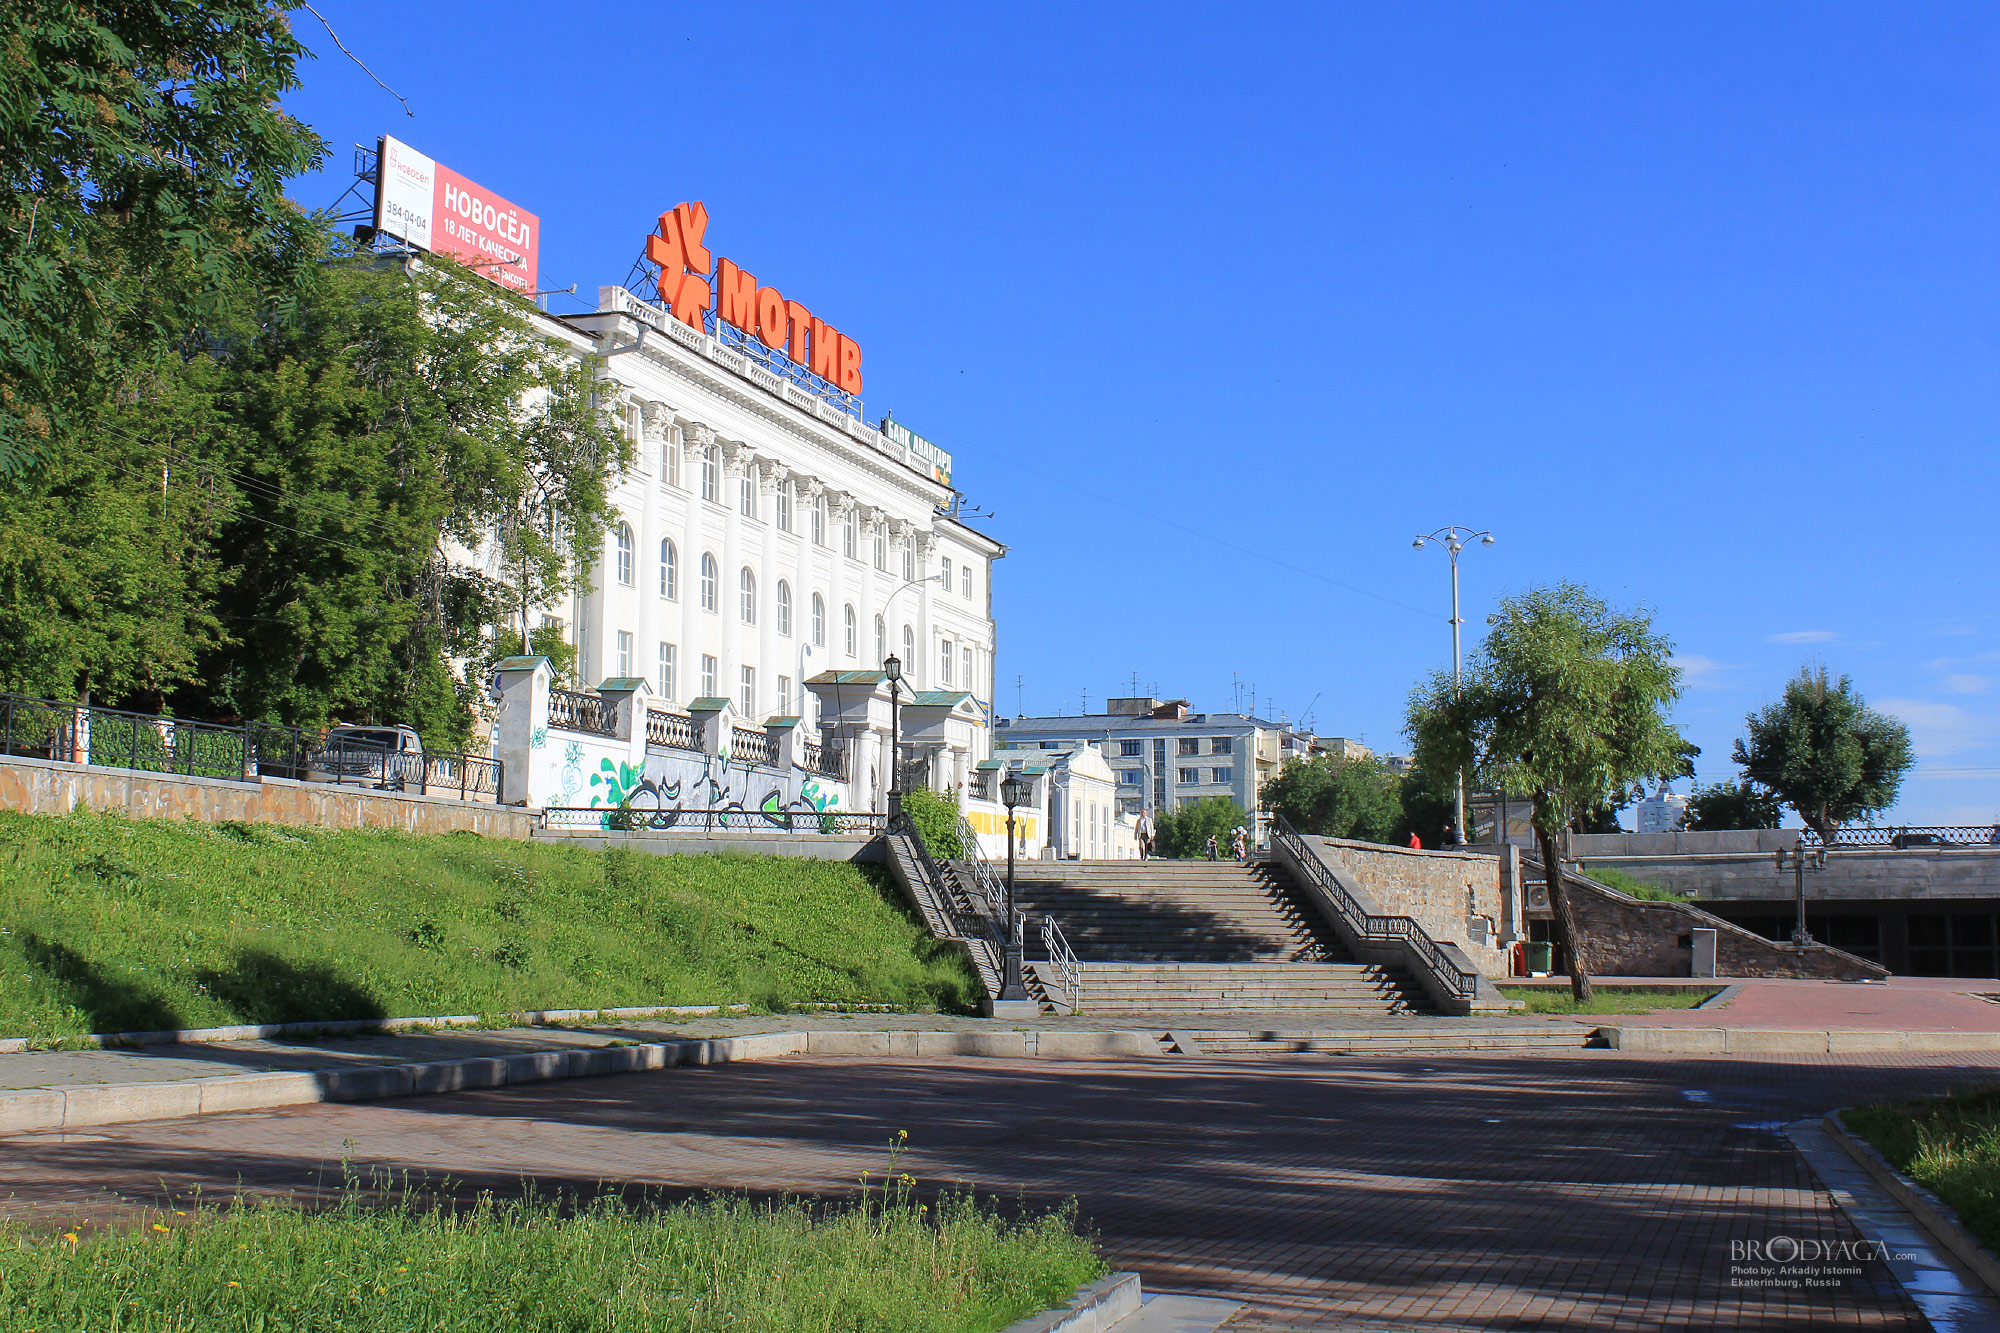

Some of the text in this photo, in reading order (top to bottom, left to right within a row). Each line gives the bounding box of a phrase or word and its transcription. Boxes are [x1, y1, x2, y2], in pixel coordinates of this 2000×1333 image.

[444, 182, 530, 250] НОВОСЁЛ
[444, 217, 456, 236] 18
[456, 224, 478, 246] ЛЕТ
[478, 235, 528, 273] КАЧЕСТА
[717, 257, 862, 396] МОТИВ
[887, 419, 952, 475] БАНК АВАНГАРД
